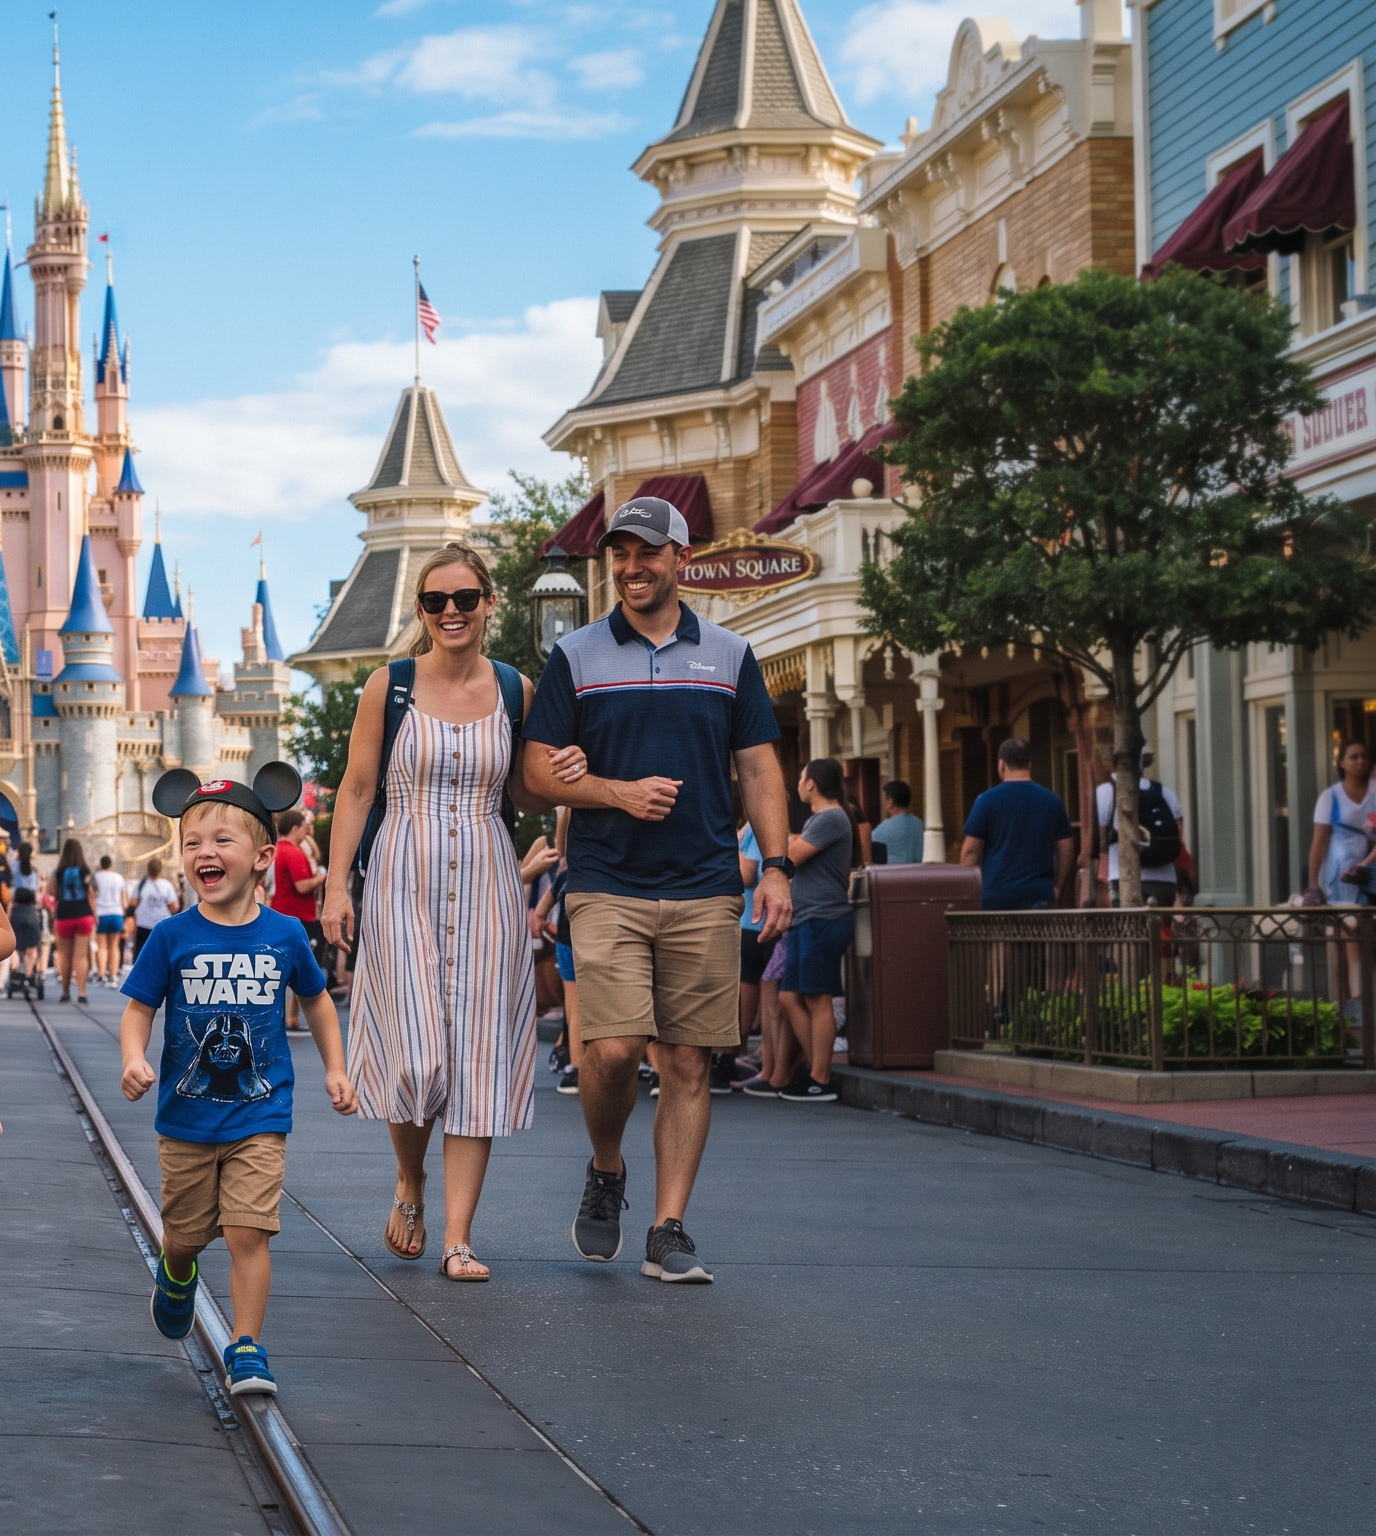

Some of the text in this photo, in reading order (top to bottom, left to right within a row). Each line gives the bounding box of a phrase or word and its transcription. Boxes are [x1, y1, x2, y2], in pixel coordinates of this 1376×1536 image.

[684, 557, 802, 581] TOWN SQUARE
[180, 953, 282, 980] STAR
[182, 979, 280, 1005] WARS
